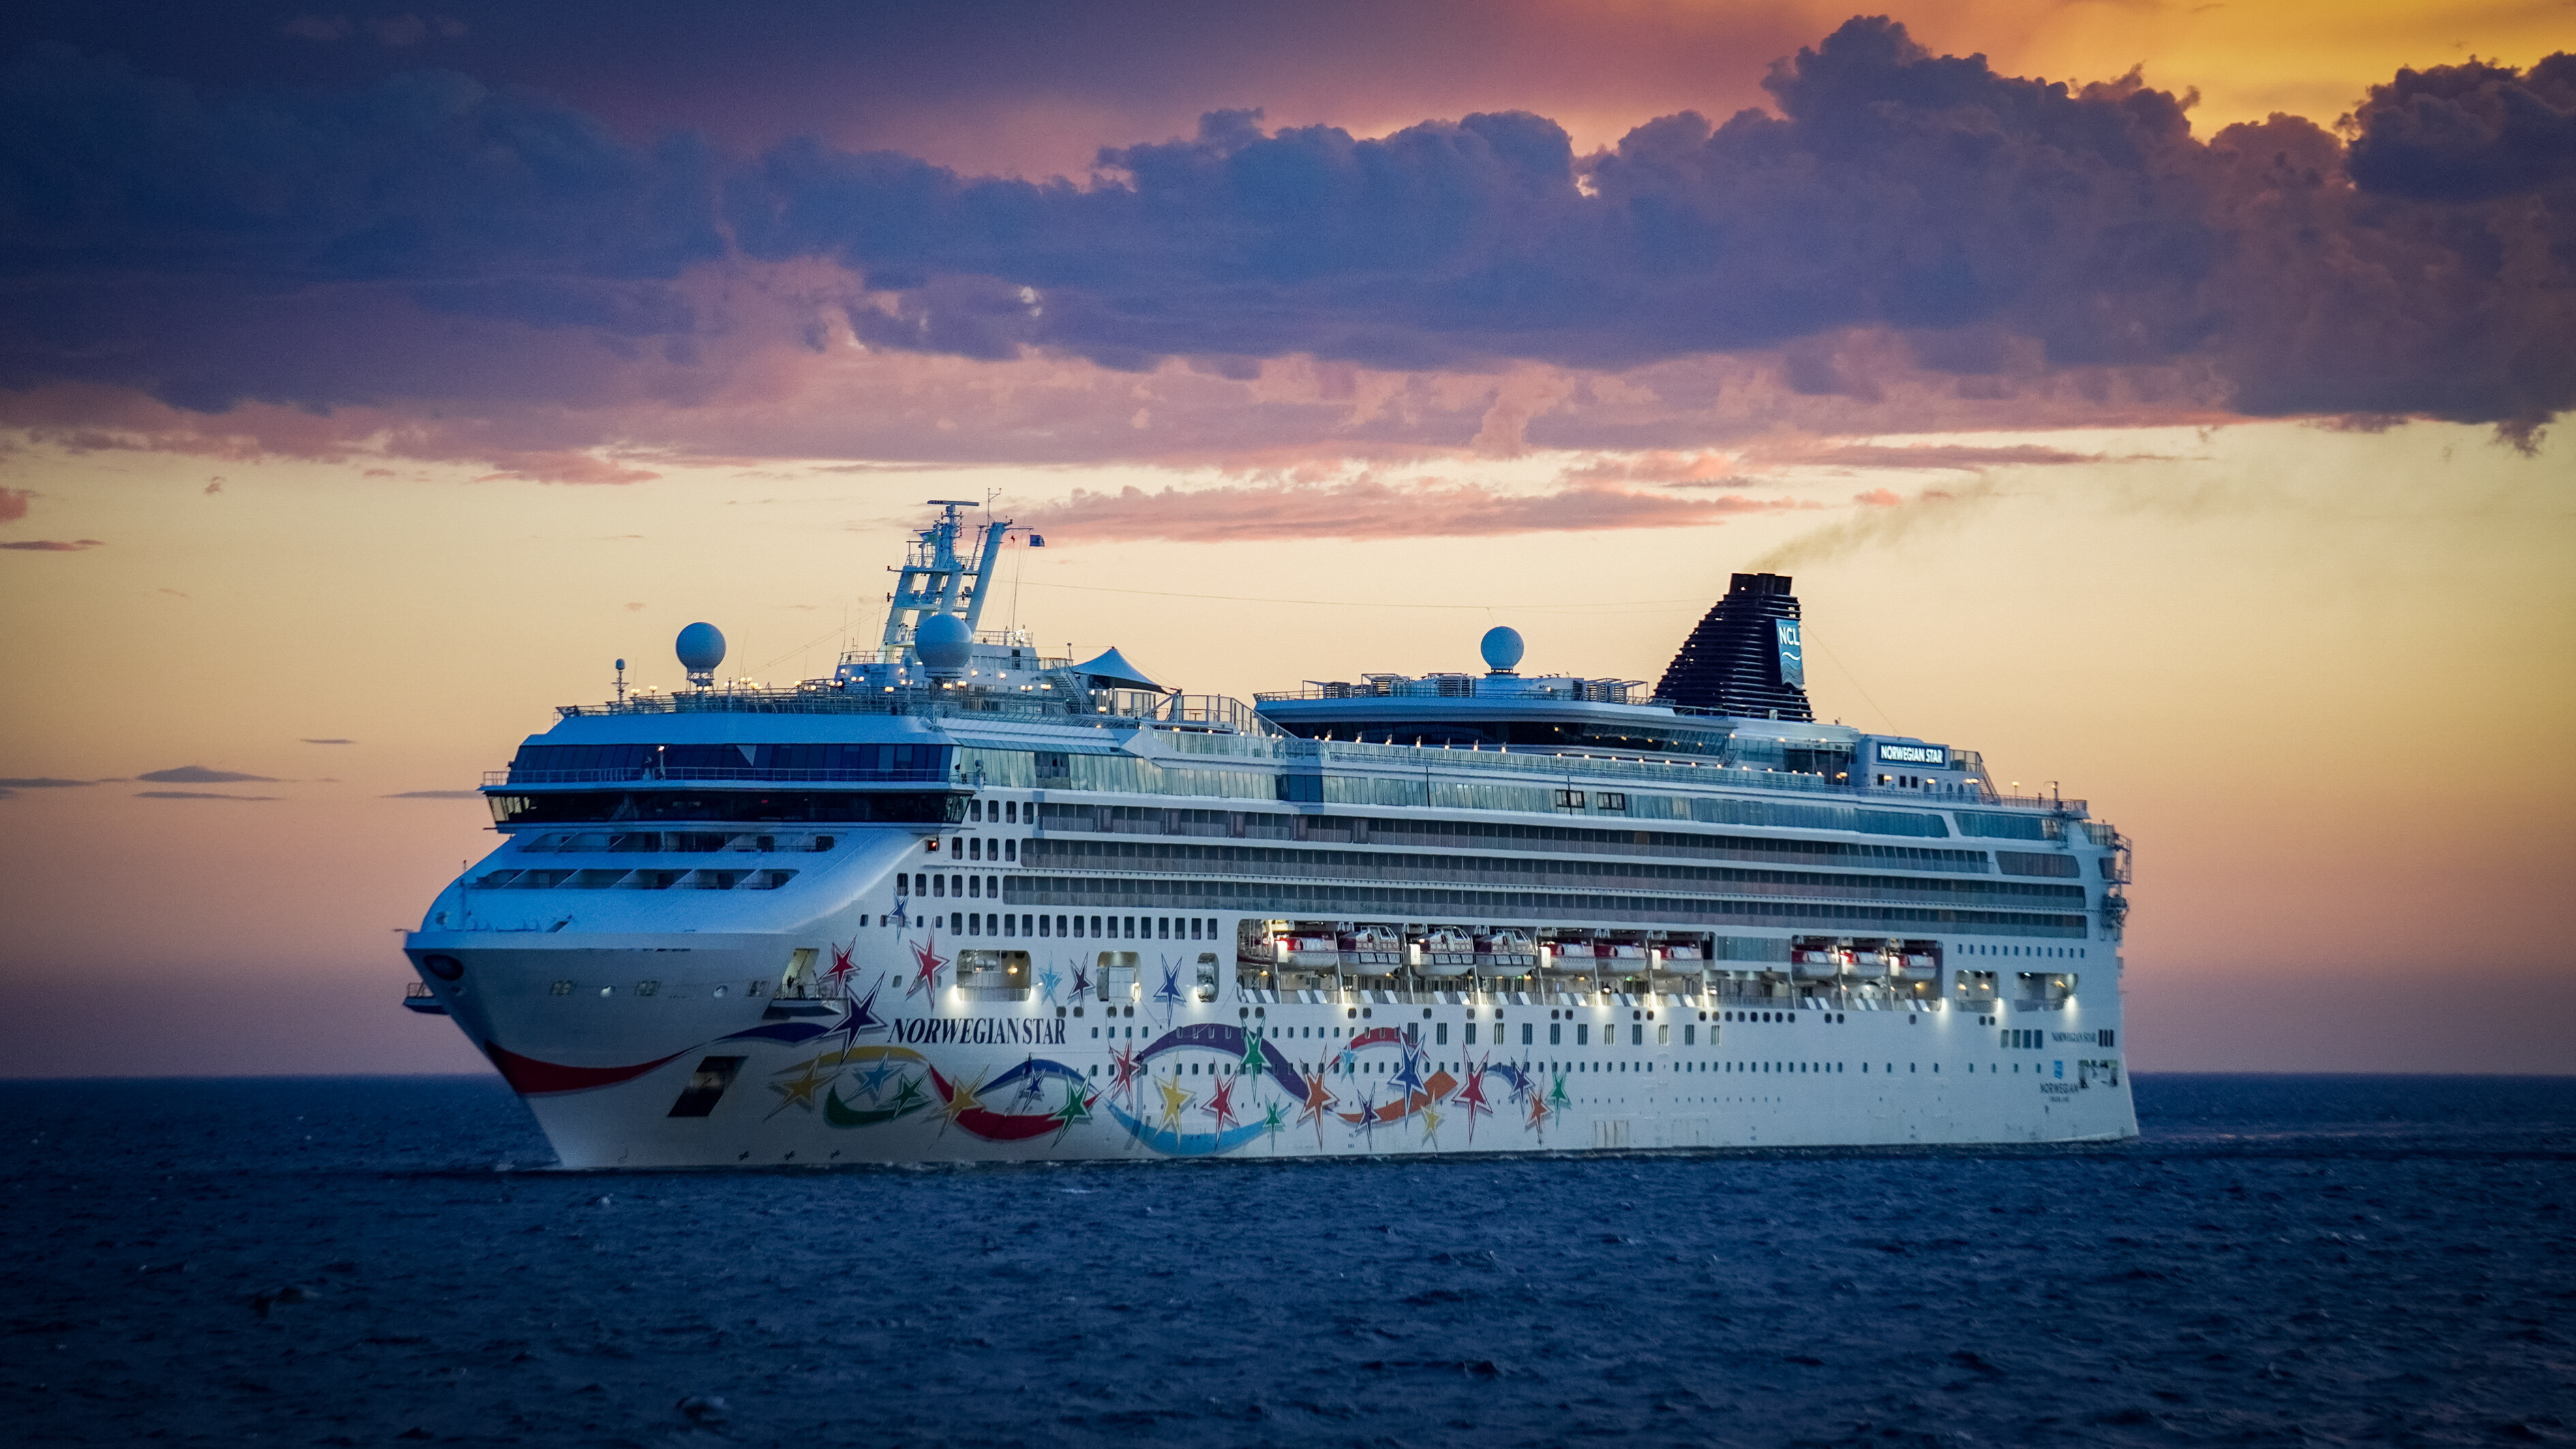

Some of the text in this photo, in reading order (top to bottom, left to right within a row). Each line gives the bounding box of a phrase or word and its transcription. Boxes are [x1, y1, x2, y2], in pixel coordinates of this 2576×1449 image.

[1778, 627, 1800, 646] NCL
[1881, 745, 1942, 763] NORWEGIAN STAR
[888, 1018, 1065, 1044] NORWEGIAN STAR
